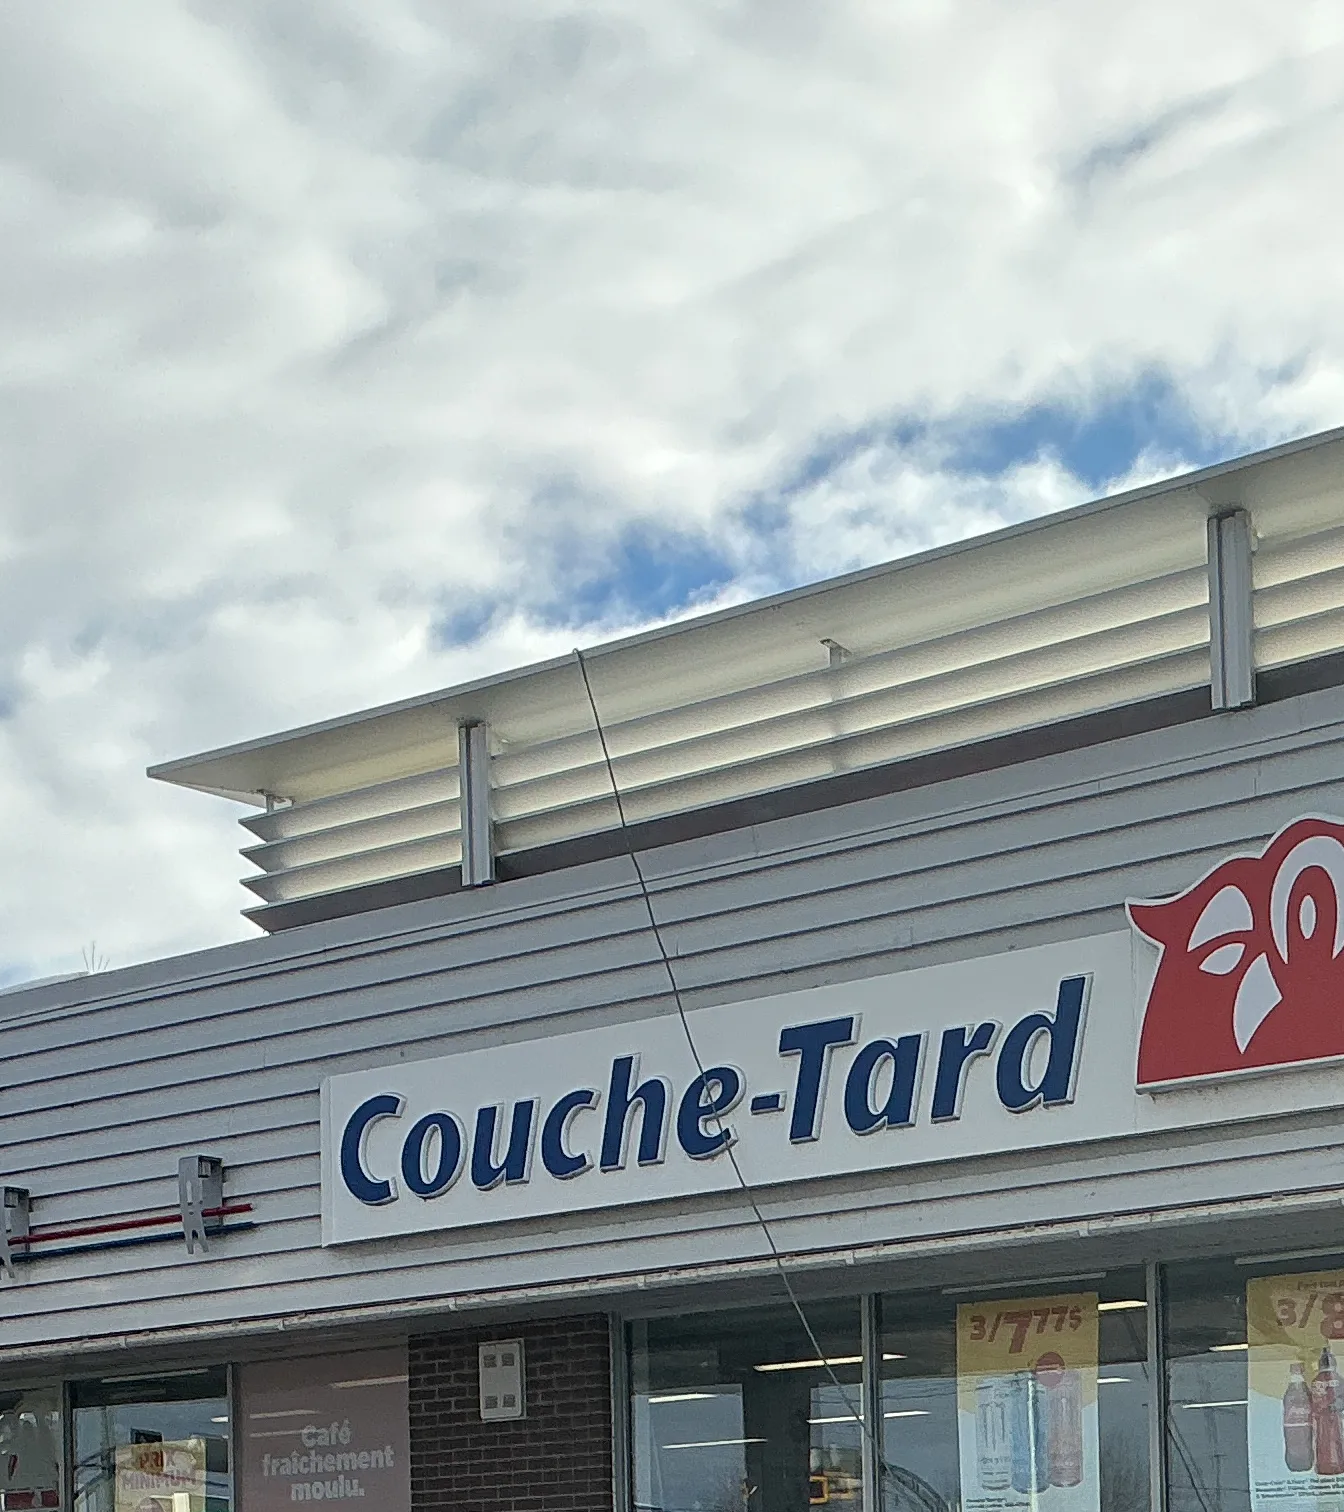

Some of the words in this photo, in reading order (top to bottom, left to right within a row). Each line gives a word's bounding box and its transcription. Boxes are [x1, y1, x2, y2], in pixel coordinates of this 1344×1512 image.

[340, 973, 1091, 1203] Couche-Tard
[301, 1418, 352, 1447] Café
[291, 1475, 365, 1500] moulu.
